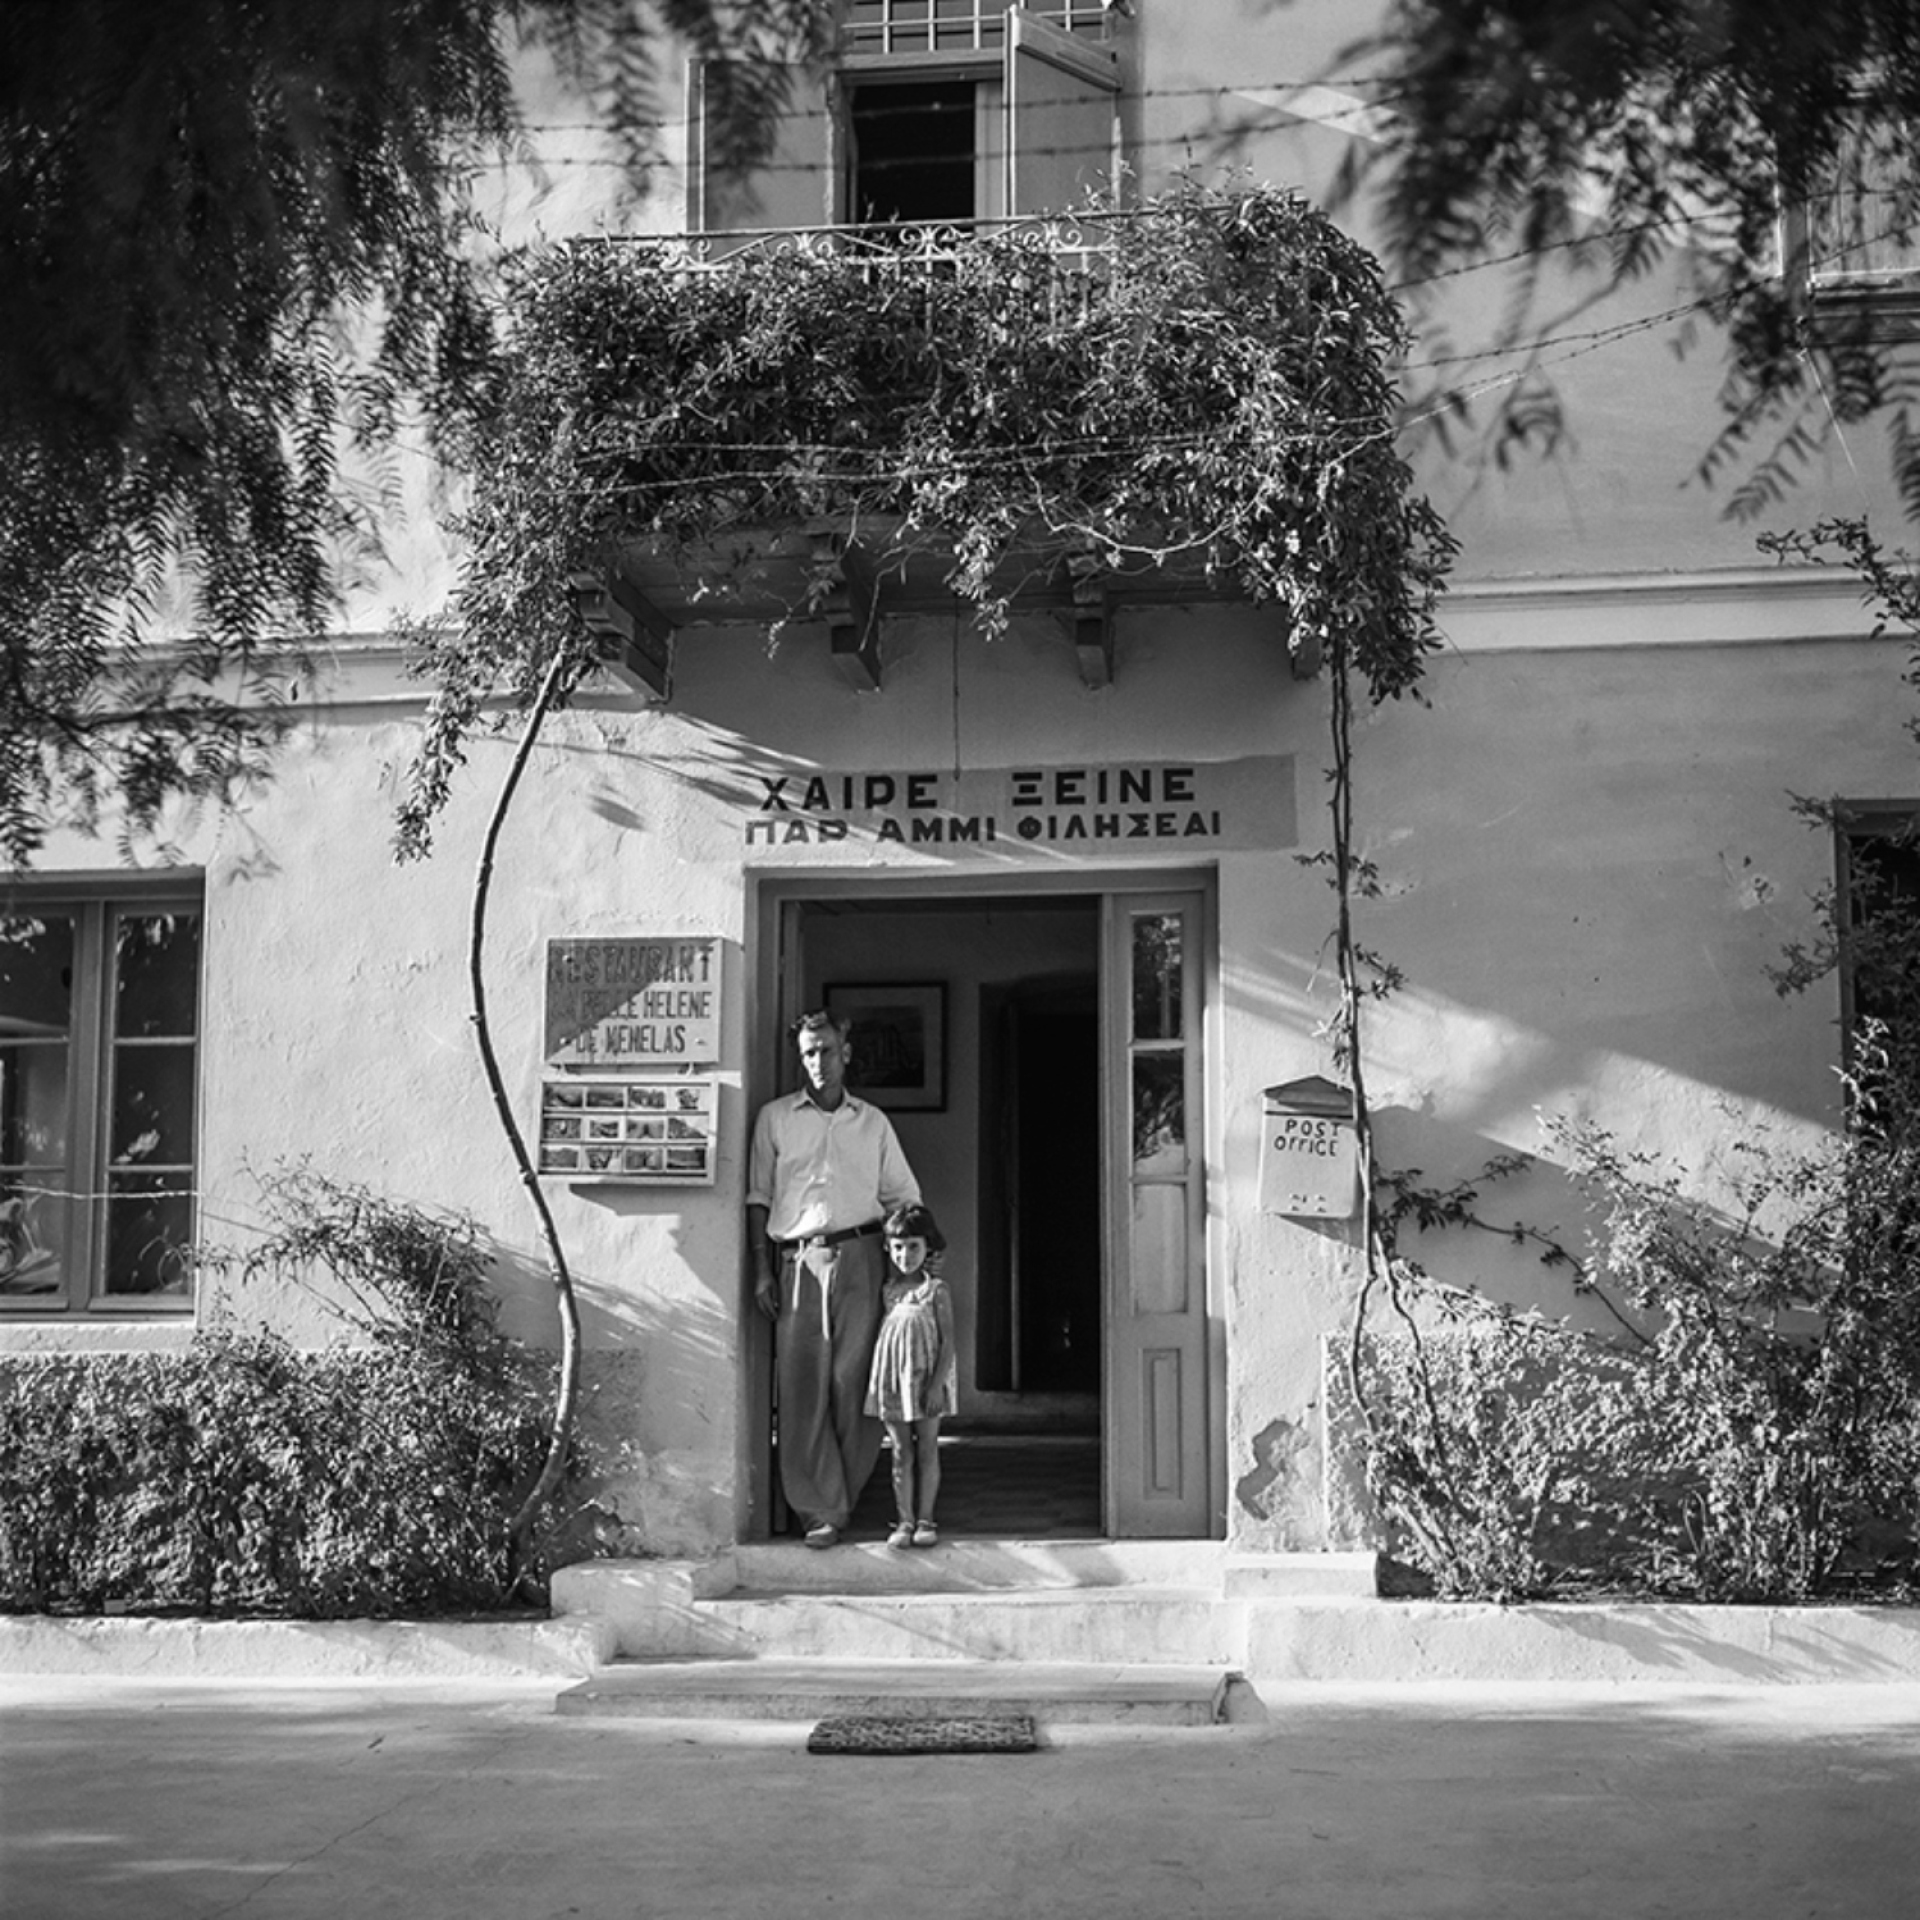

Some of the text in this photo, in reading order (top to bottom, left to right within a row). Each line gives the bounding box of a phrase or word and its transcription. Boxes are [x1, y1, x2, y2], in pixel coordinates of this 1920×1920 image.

[761, 768, 1194, 811] ΧΑΙΡΕ ΞΕΙΝΕ
[745, 811, 1220, 845] ΠΑΡ ΑΜΜΙ ΦΙΛΗΣΕΑΙ
[550, 945, 713, 983] RESTAURANT
[644, 991, 712, 1019] HELENE
[577, 1024, 686, 1053] DE MENELAS
[1285, 1118, 1342, 1138] POST
[1274, 1136, 1338, 1156] OFFICE
